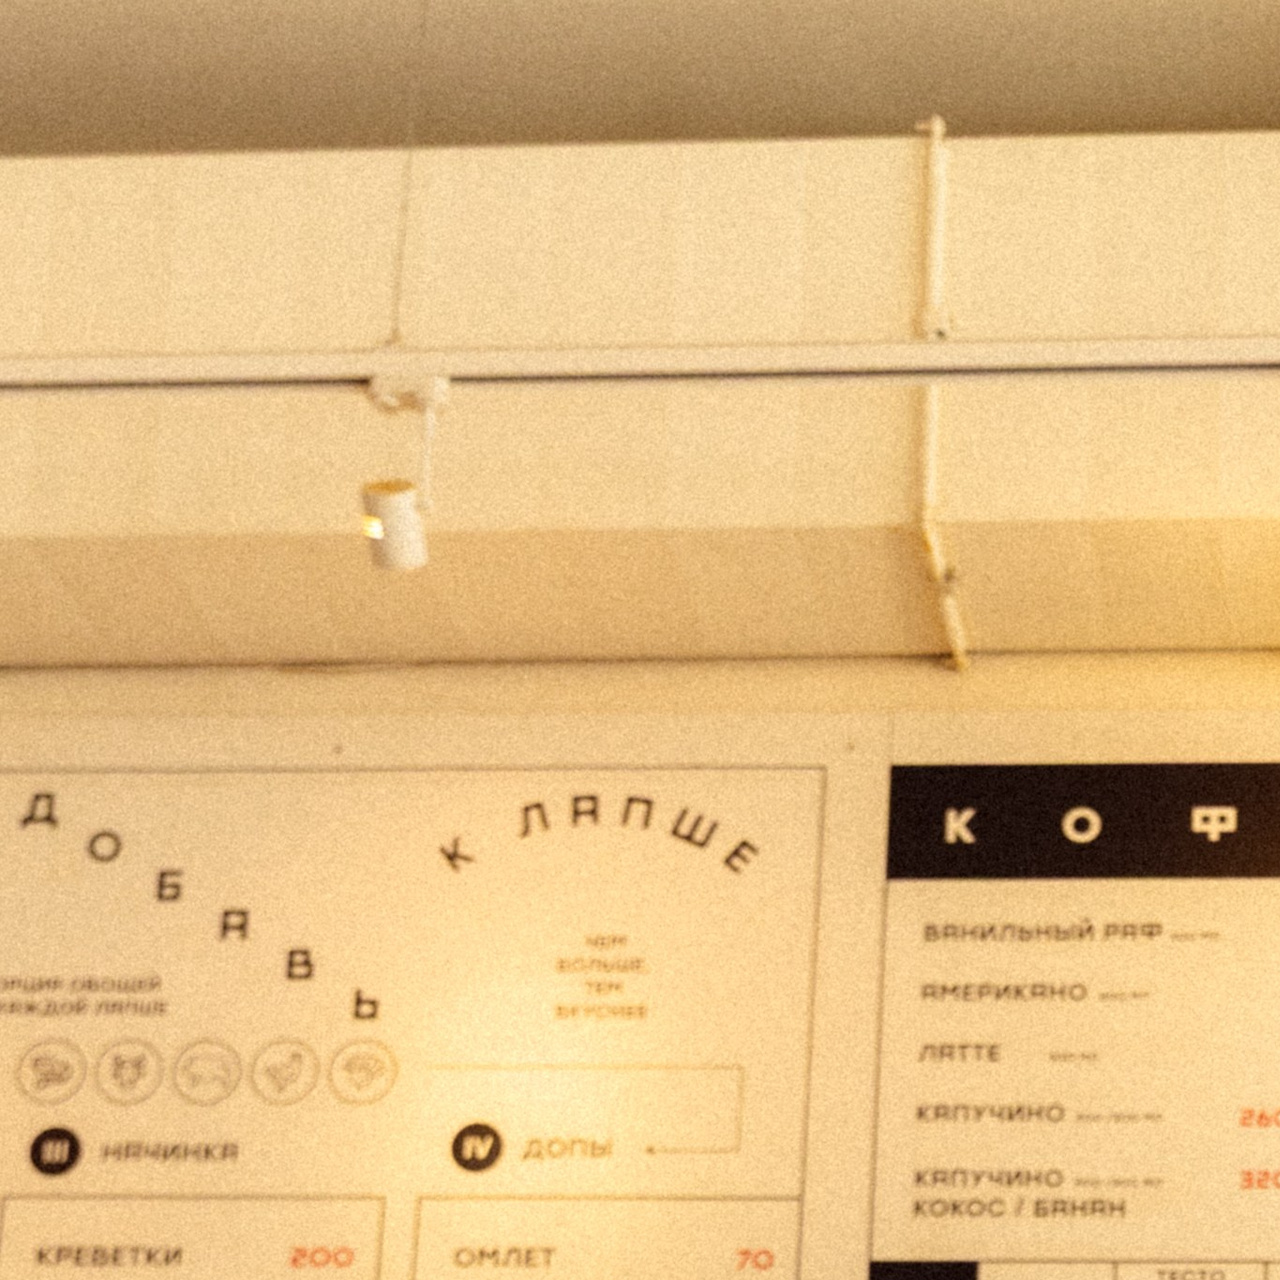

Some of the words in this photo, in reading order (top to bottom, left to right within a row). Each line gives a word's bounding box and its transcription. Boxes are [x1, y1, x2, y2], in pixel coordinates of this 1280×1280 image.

[440, 837, 474, 871] К
[1103, 921, 1164, 940] РАФ
[921, 982, 1089, 1002] АМЕРИКАНО
[919, 1042, 1001, 1063] ЛАТТЕ
[915, 1103, 1067, 1124] КАПУЧИНО
[522, 1137, 614, 1162] ДОПЫ
[914, 1168, 1065, 1189] КАПУЧИНО
[912, 1197, 1006, 1219] КОКОС
[1033, 1198, 1128, 1219] БАНАН
[36, 1245, 184, 1268] КРЕВЕТКИ
[289, 1246, 356, 1270] 200
[454, 1246, 557, 1269] ОМЛЕТ
[738, 1248, 777, 1272] 70
